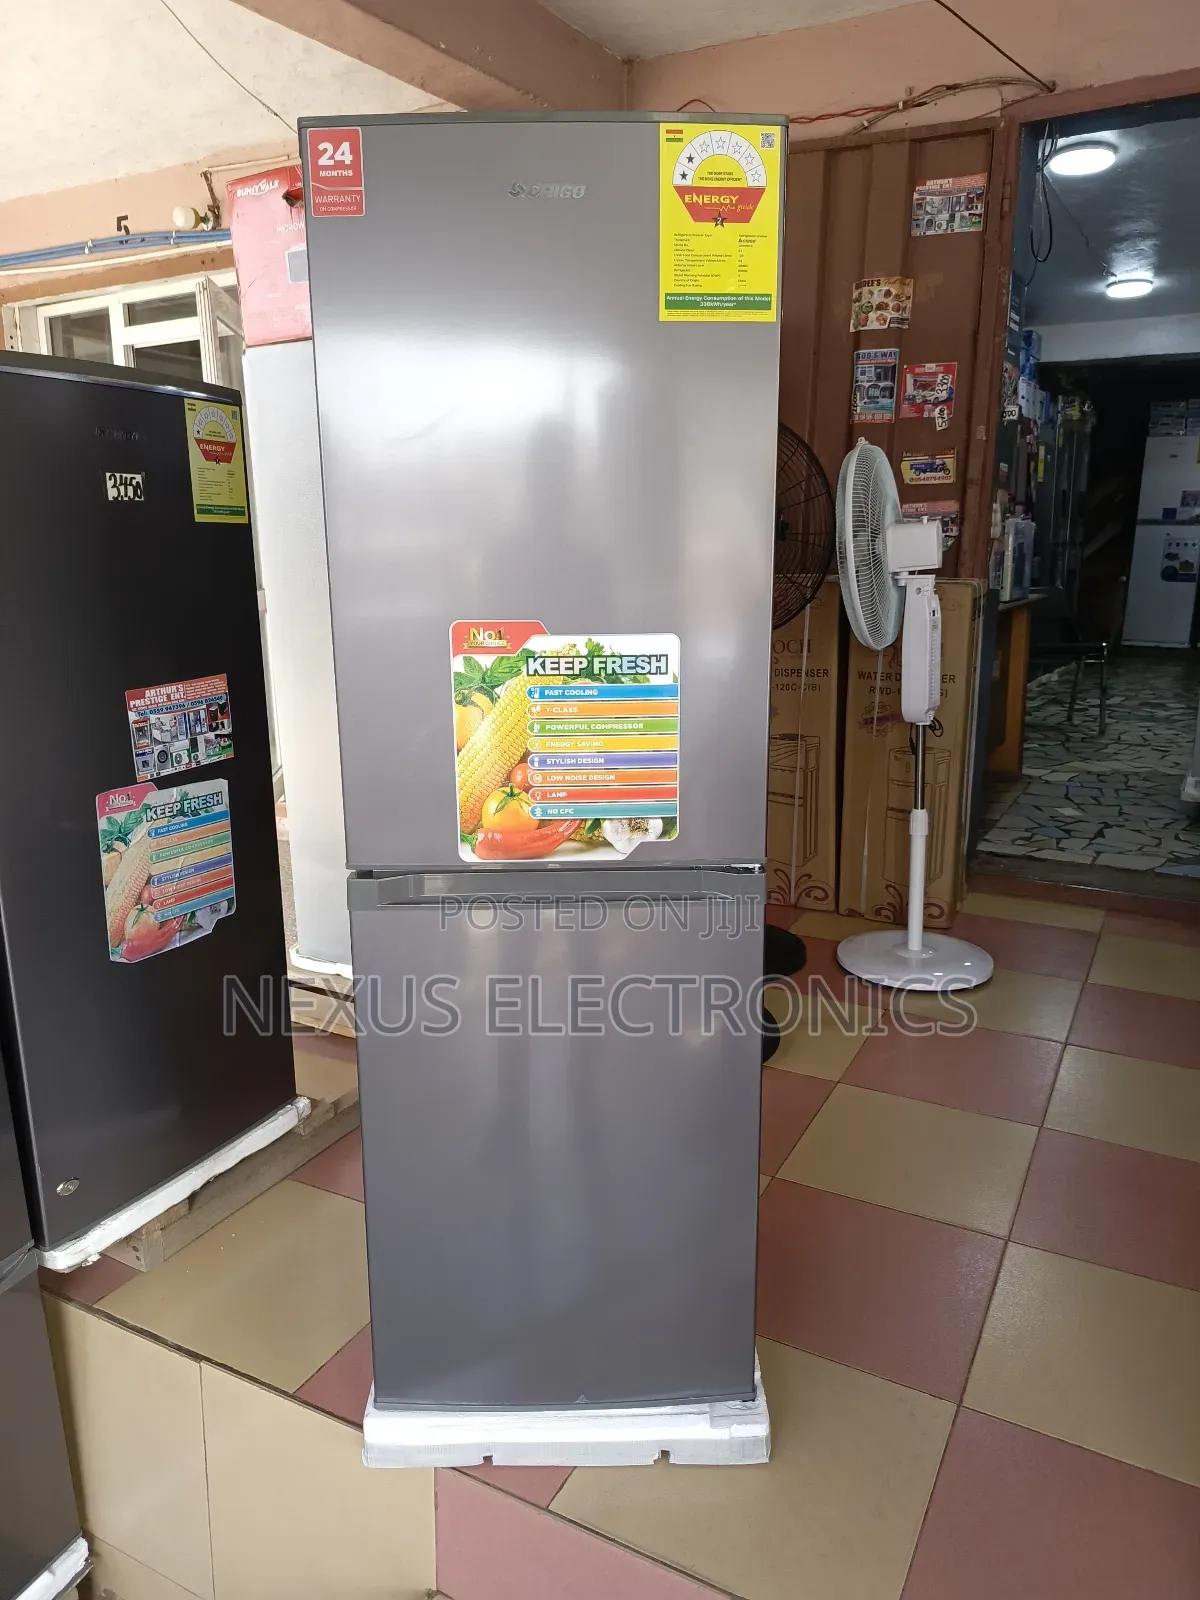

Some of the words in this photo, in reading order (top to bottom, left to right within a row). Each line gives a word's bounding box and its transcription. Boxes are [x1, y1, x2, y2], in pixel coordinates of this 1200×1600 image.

[317, 141, 353, 166] 24
[319, 169, 353, 178] MONTHS
[315, 194, 361, 204] WARRANTY
[685, 192, 740, 206] ENERGY
[199, 443, 225, 453] ENERGY
[526, 655, 588, 676] KEEP
[591, 654, 669, 675] FRESH
[774, 668, 829, 678] DISPENSER
[857, 670, 892, 681] WATER
[144, 684, 184, 699] ARTHUR'S
[564, 688, 599, 696] COOLING
[129, 694, 168, 708] PRESTIGE
[590, 722, 644, 730] COMPRESSOR
[546, 757, 577, 765] STYLISH
[588, 773, 616, 781] DESIGN
[145, 801, 181, 823] KEEP
[183, 791, 224, 813] FRESH
